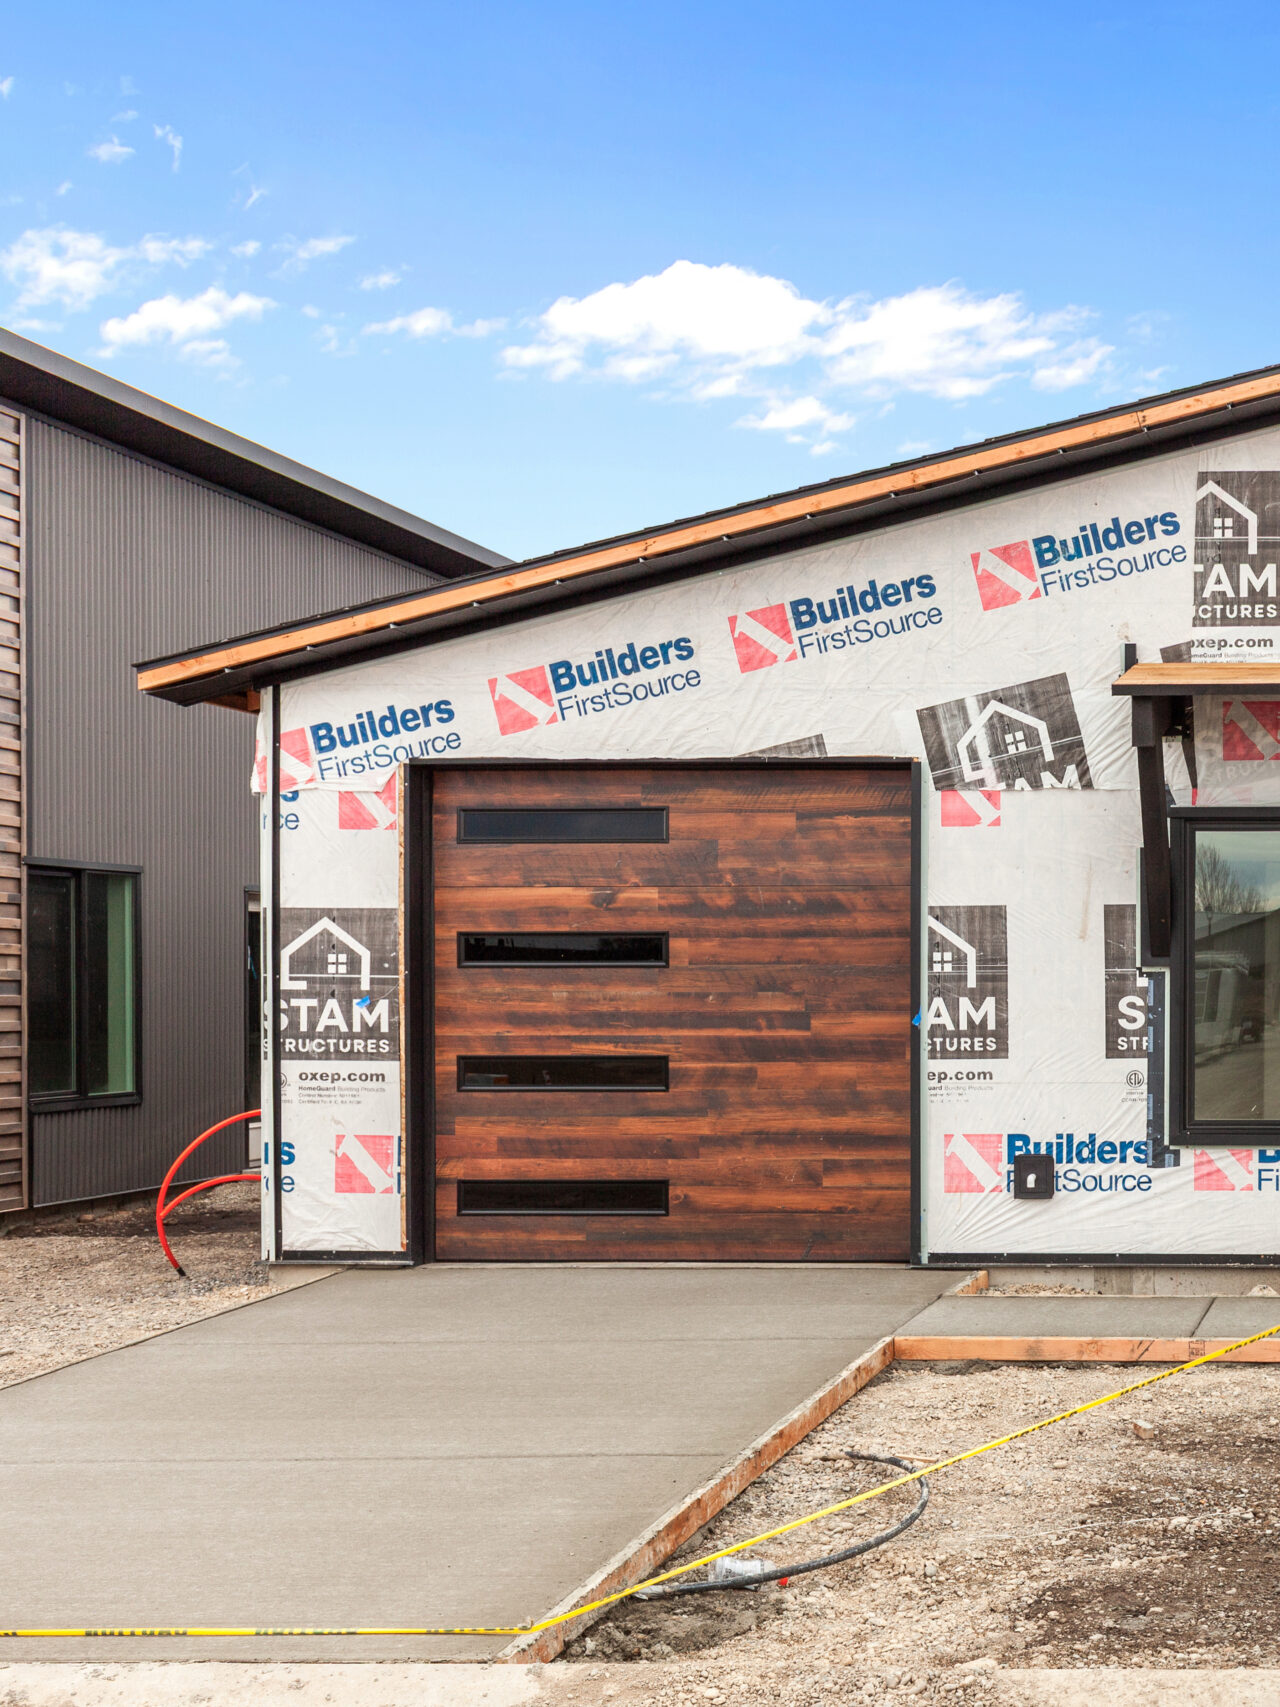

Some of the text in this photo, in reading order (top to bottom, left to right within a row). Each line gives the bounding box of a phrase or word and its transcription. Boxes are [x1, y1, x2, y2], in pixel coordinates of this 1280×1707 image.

[1031, 511, 1181, 568] Builders
[1041, 541, 1188, 597] FirstSource
[788, 573, 936, 631] Builders
[1192, 604, 1277, 618] CTURES
[797, 604, 943, 658] FirstSource
[549, 637, 695, 694] Builders
[557, 667, 702, 721] FirstSource
[309, 698, 455, 755] Builders
[317, 730, 461, 781] FirstSource
[263, 998, 389, 1033] STAM
[264, 1038, 390, 1053] SRUCTURES
[298, 1071, 387, 1084] oxep.com
